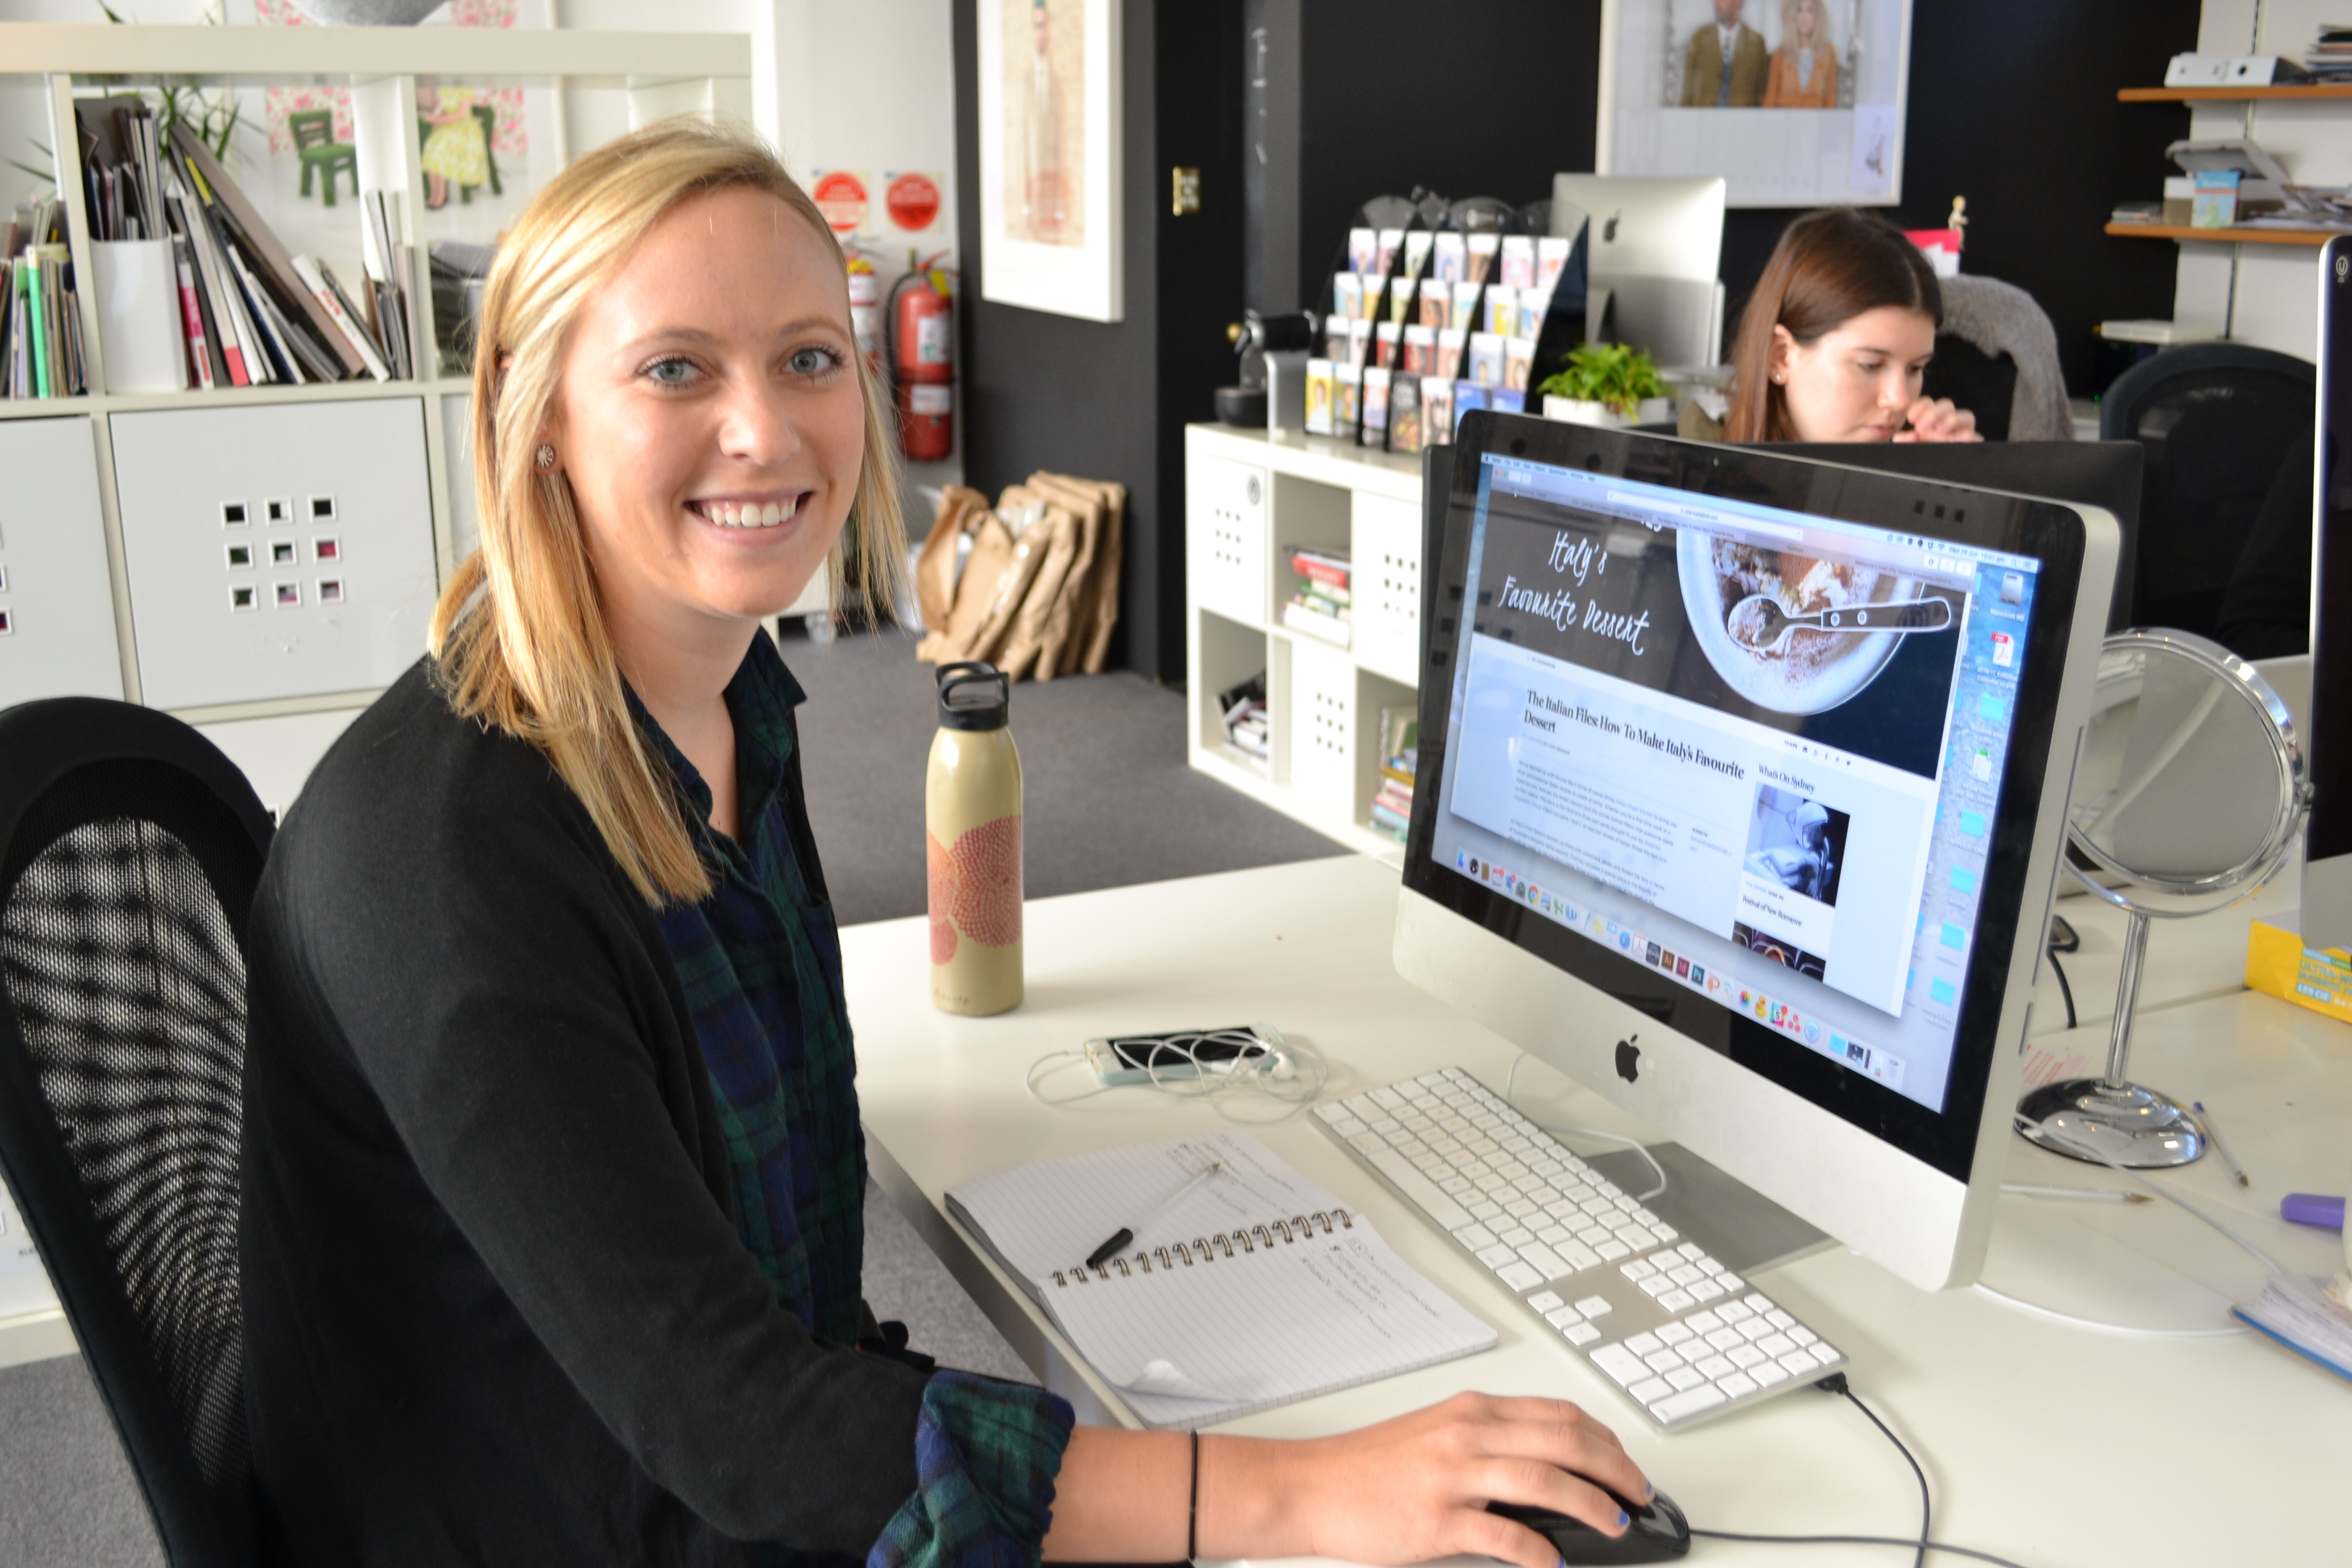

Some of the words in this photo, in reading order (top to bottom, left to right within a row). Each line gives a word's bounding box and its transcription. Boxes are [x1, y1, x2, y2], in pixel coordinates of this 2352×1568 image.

[1548, 530, 1608, 587] Italy's
[1497, 575, 1577, 633] Favourite
[1583, 599, 1649, 657] Dessert
[1990, 607, 2015, 620] Macintosh
[1994, 634, 2005, 643] PDF
[1524, 709, 1556, 734] Dessert
[1527, 689, 1544, 708] The
[1546, 697, 1574, 719] Italian
[1600, 715, 1622, 736] How
[1624, 723, 1635, 741] To
[1637, 728, 1664, 751] Make
[1666, 739, 1693, 763] Italy's
[1695, 749, 1745, 780] Favourite
[1779, 772, 1791, 785] On
[1791, 777, 1816, 795] Sydney
[1743, 895, 1760, 911] Festival
[1766, 905, 1777, 916] New
[1777, 910, 1802, 927] Romance
[1664, 954, 1673, 966] Ai
[1679, 962, 1687, 974] Id
[1693, 969, 1702, 982] Ps
